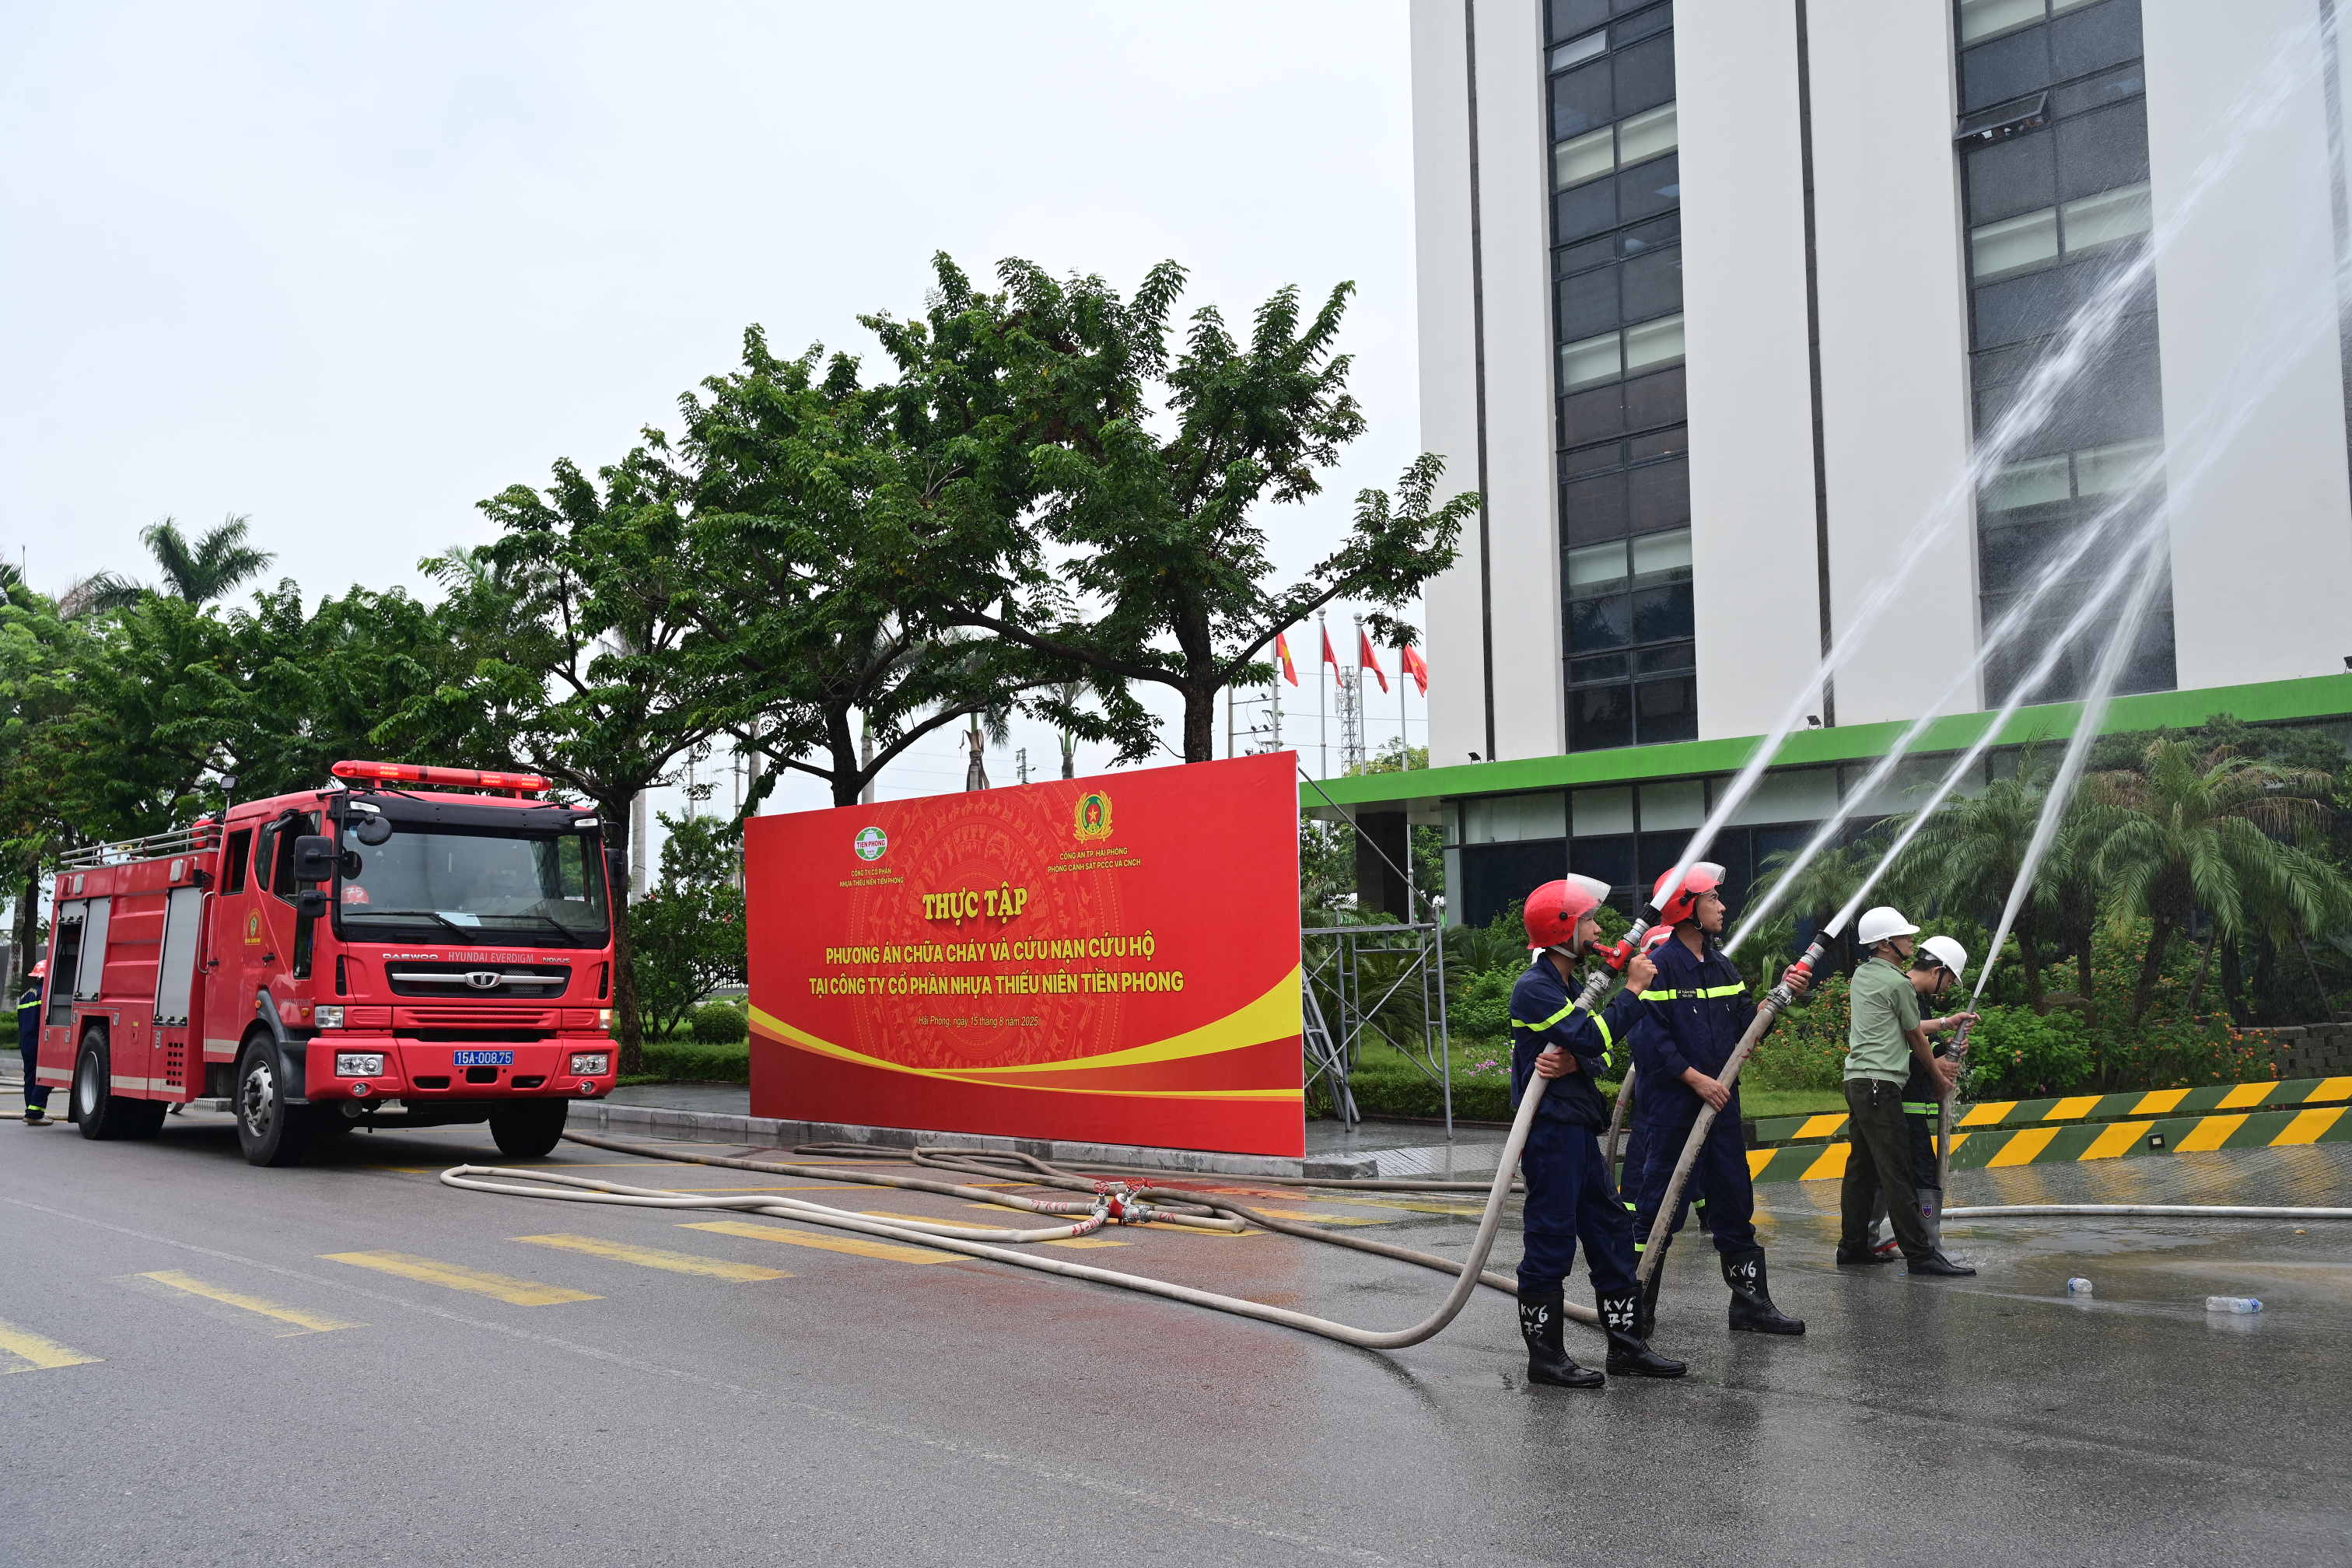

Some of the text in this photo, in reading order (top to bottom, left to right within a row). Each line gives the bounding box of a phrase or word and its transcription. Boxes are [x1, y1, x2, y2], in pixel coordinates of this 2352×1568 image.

[1059, 850, 1076, 859] CÔNG
[922, 880, 1027, 926] THỰC TẬP
[826, 929, 1156, 964] PHƯƠNG ÁN CHỮA CHÁY VÀ CỨU NẠN CỨU HỘ
[448, 951, 534, 964] HYUNDAI EVERDIGM
[809, 967, 1185, 999] TẠI CÔNG TY CỔ PHẦN NHỰA THIẾU NIÊN TIỀN PHONG
[971, 1015, 978, 1025] 15
[1021, 1016, 1039, 1027] 2025
[457, 1052, 513, 1064] 15A-008.75
[1727, 1260, 1757, 1278] KV6
[1603, 1297, 1636, 1312] KV6
[1521, 1303, 1549, 1323] KV6
